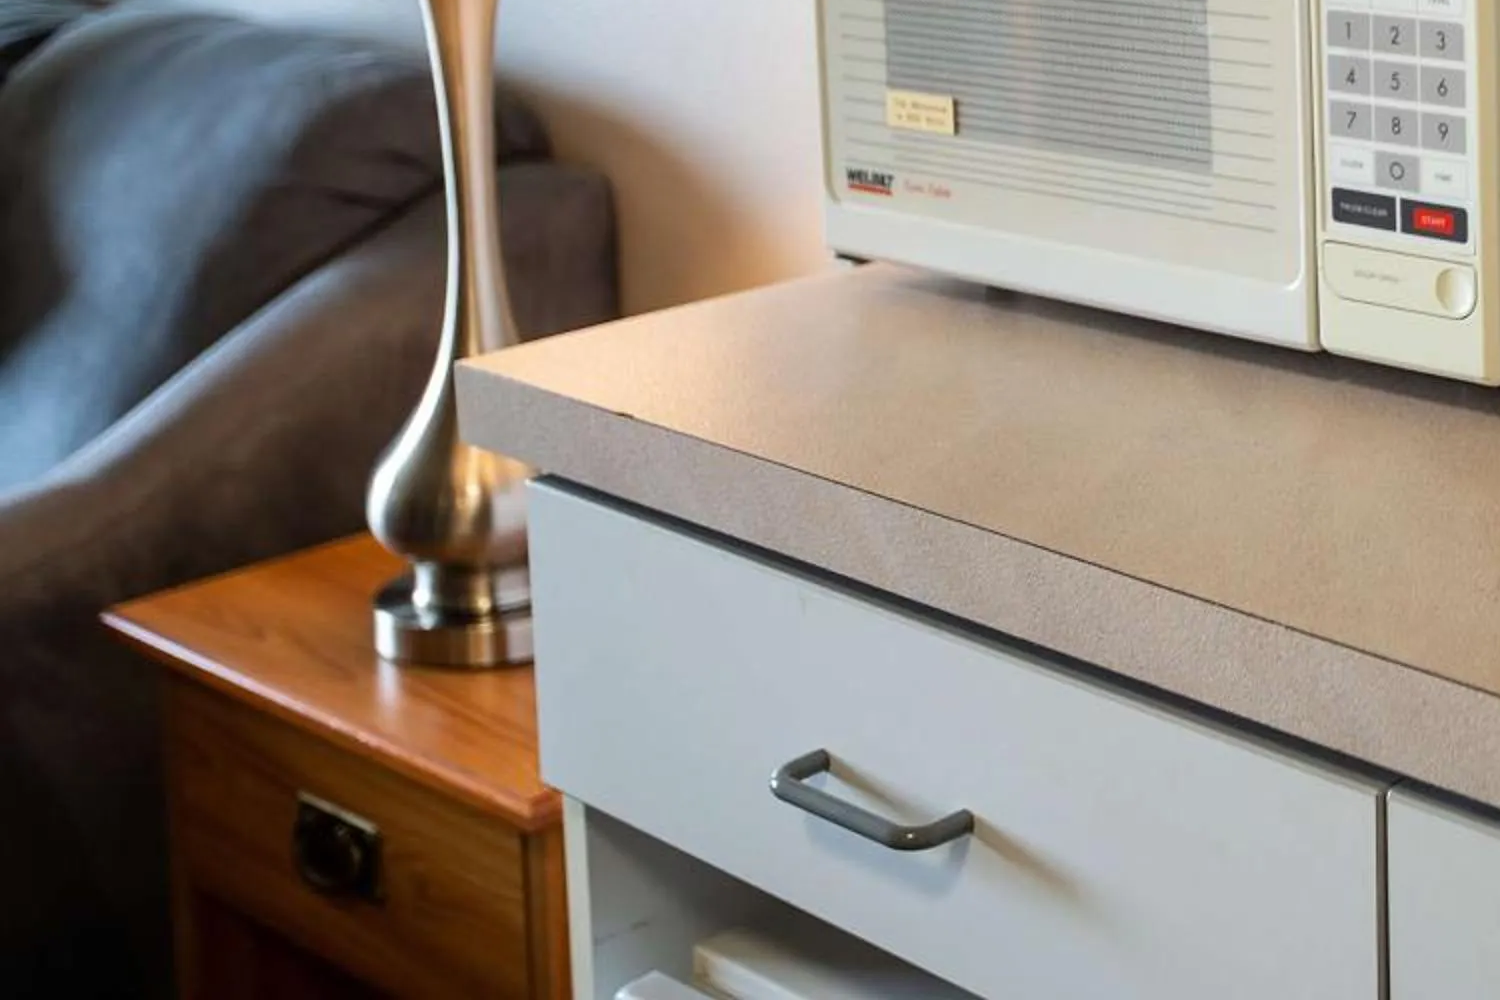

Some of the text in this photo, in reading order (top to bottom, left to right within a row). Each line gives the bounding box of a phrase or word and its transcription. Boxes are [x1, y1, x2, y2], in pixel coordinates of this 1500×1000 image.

[1345, 21, 1446, 51] 1 2 3
[1346, 68, 1448, 97] 4 5 6
[1347, 111, 1449, 141] 7 8 9
